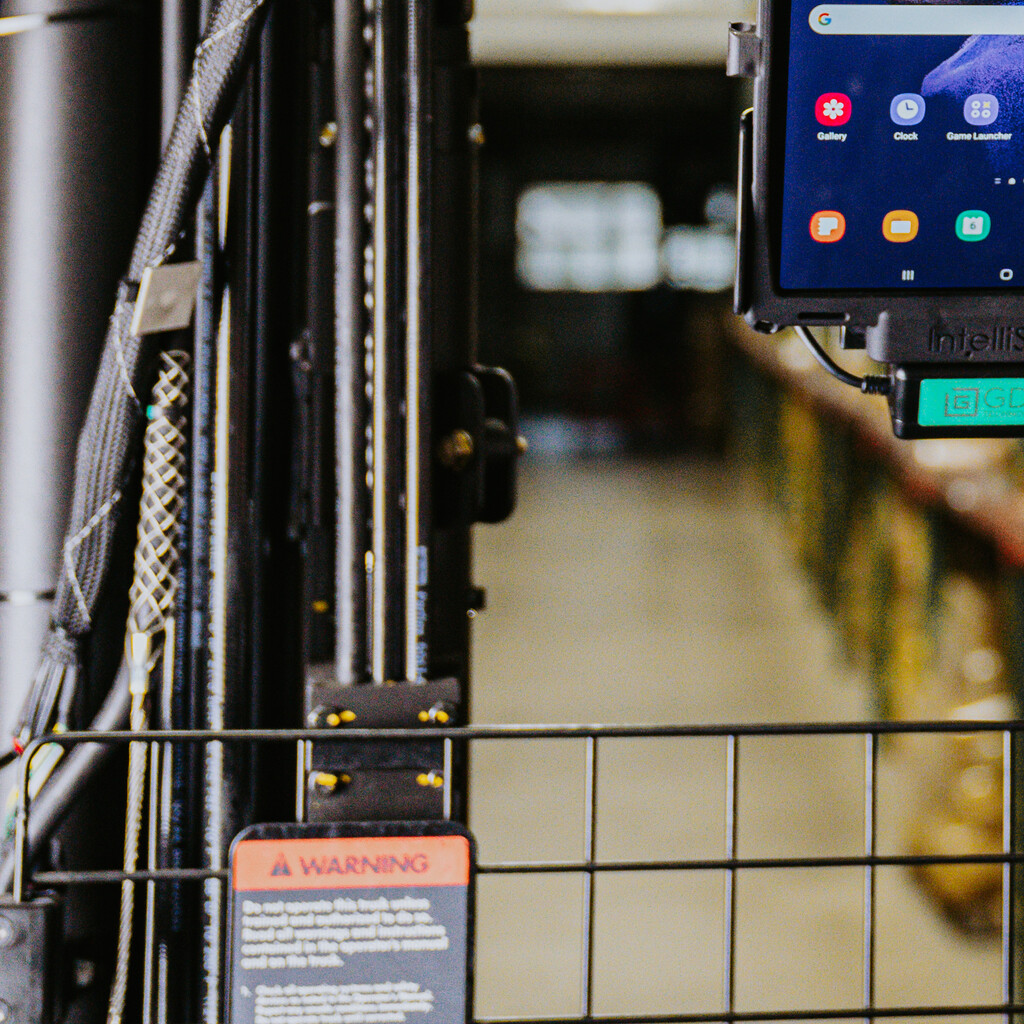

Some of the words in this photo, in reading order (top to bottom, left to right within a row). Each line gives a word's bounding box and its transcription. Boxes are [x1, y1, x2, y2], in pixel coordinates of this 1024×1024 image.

[817, 131, 848, 142] Gallery
[893, 131, 919, 141] Clock
[946, 131, 972, 141] Game
[973, 131, 1012, 141] Launcher
[300, 853, 428, 876] WARNING
